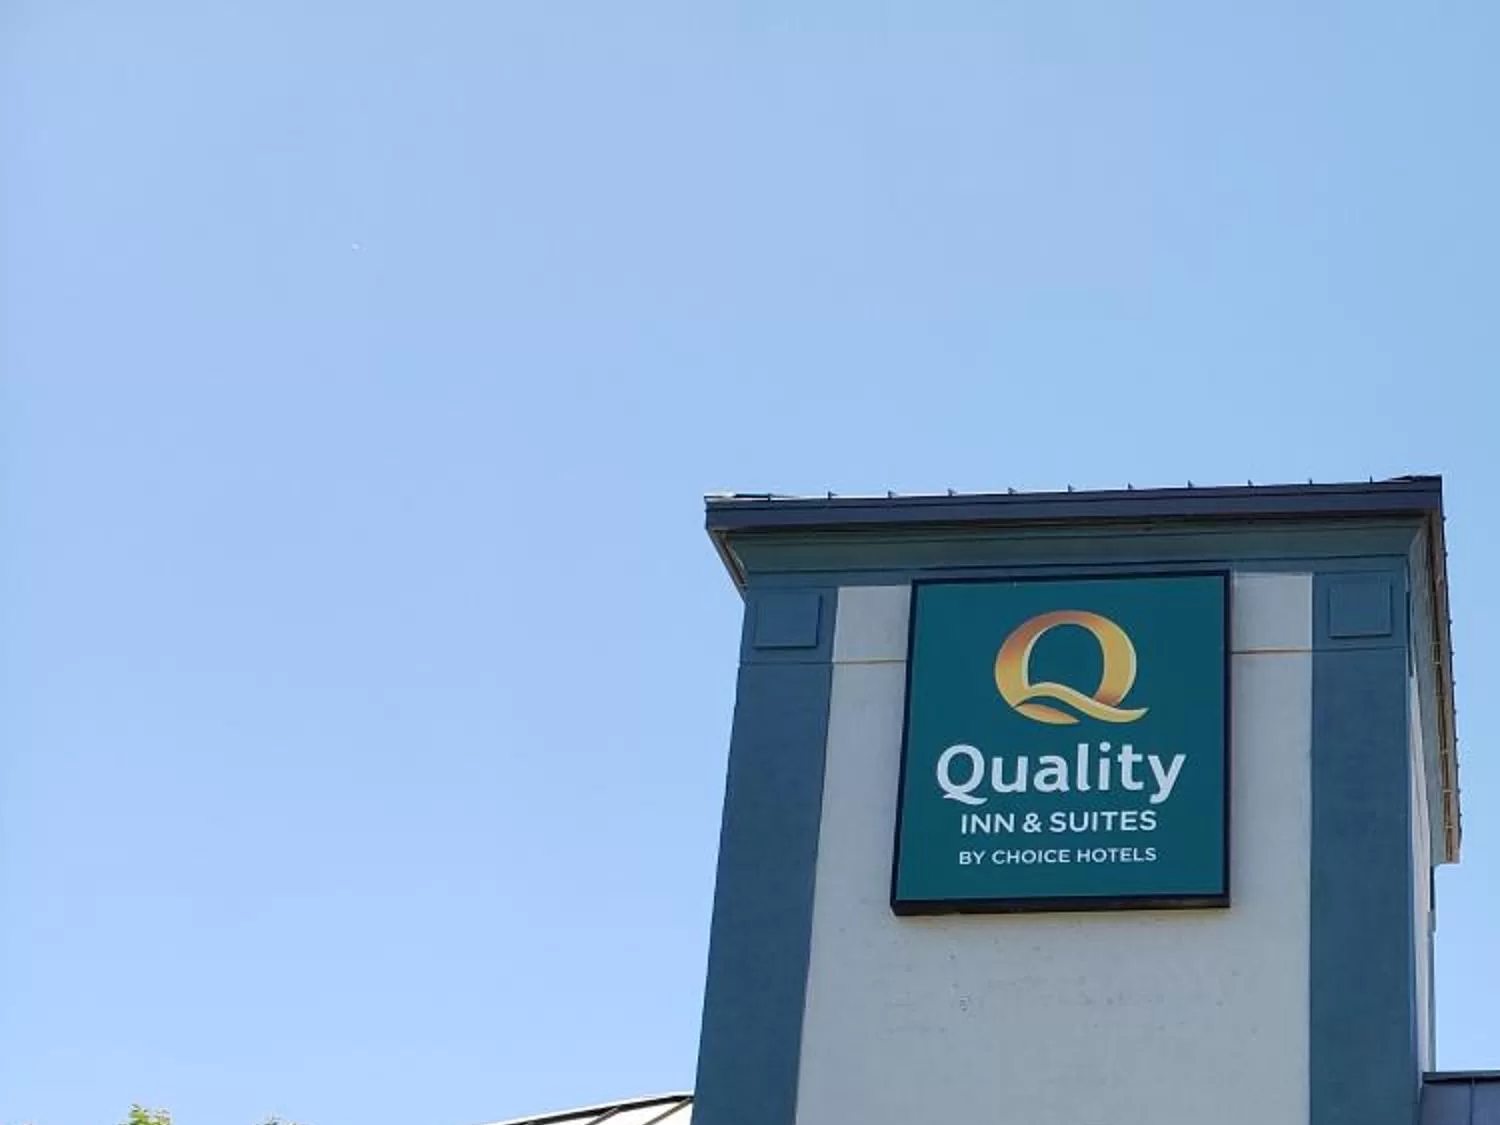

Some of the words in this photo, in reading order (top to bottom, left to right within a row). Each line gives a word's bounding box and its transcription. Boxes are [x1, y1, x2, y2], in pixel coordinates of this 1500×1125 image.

[936, 743, 1186, 805] Quality
[960, 812, 1015, 834] INN
[1021, 812, 1042, 833] &
[1048, 809, 1157, 833] SUITES
[958, 850, 986, 865] BY
[991, 848, 1071, 865] CHOICE
[1076, 846, 1157, 864] HOTELS
